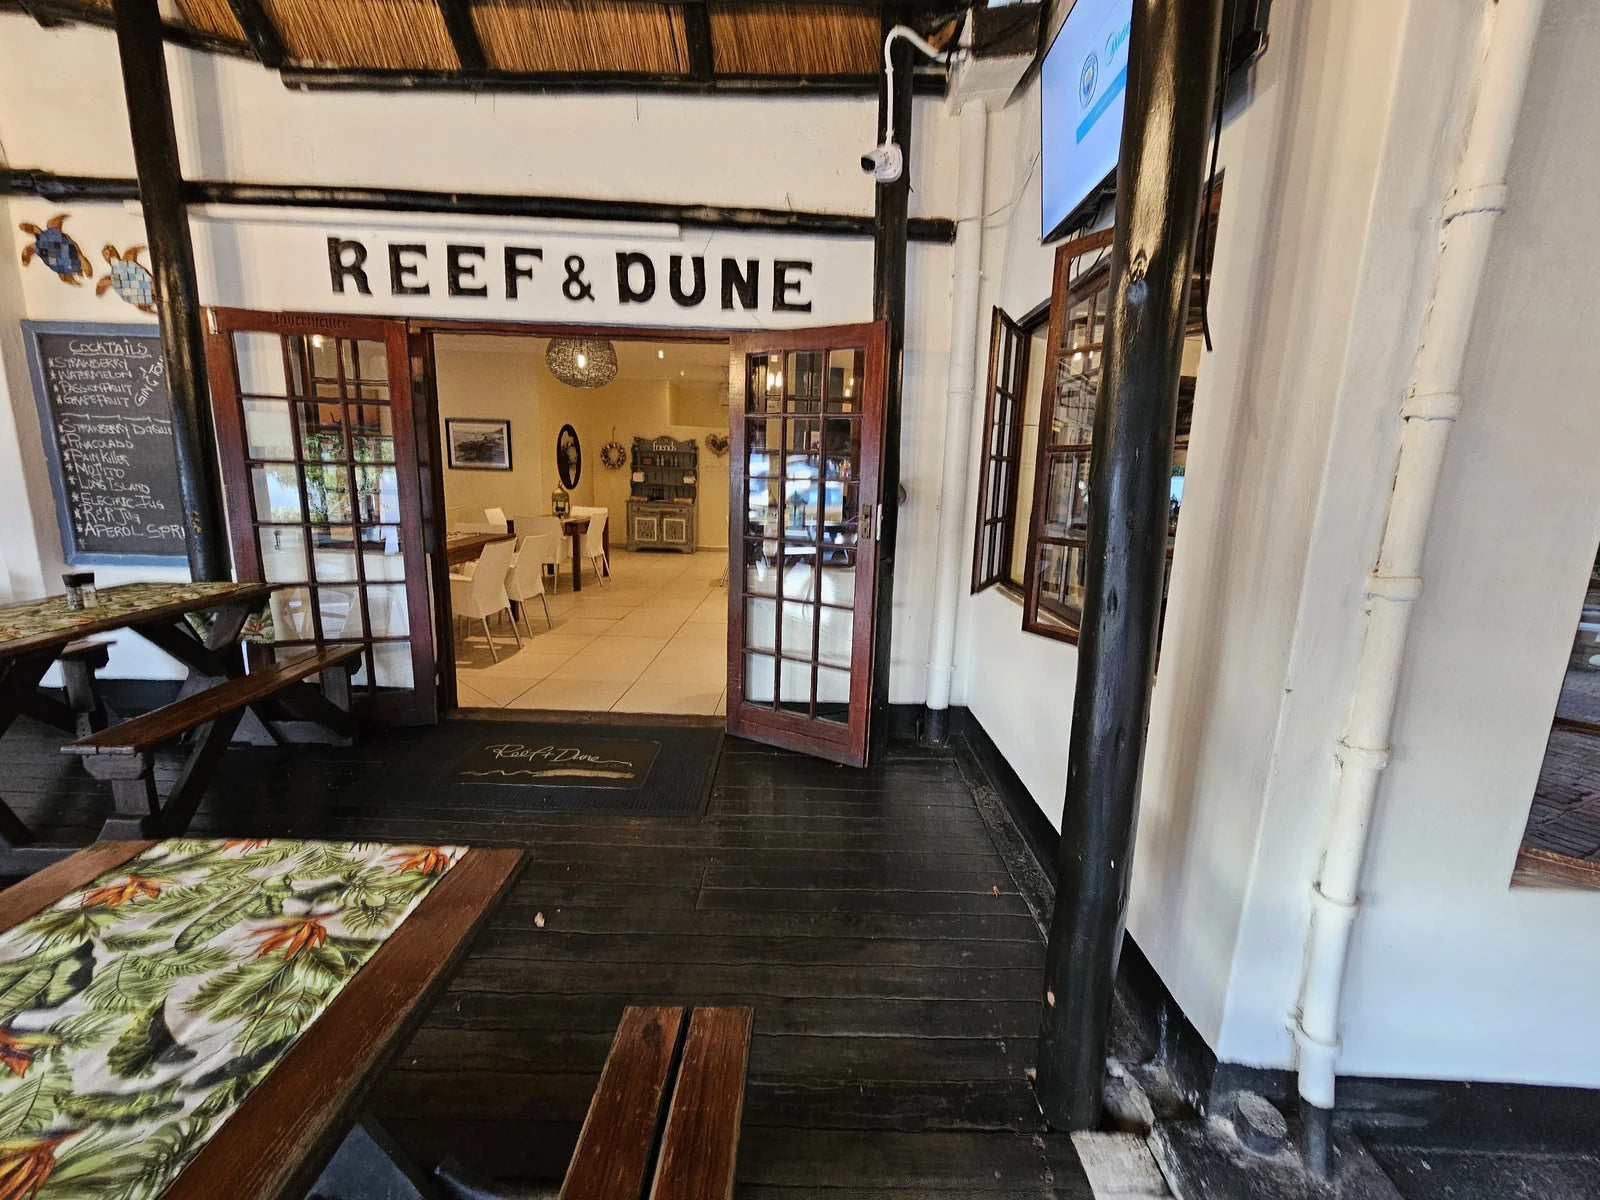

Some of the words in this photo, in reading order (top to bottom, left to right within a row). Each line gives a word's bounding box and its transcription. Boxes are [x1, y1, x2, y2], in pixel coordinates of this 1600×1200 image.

[326, 235, 543, 301] REEF
[562, 254, 595, 304] &
[615, 251, 813, 314] DUNE
[55, 357, 128, 370] STRAWBERRY
[59, 369, 132, 381] WATERMELON
[64, 393, 130, 407] GRAPEFRUIT
[67, 448, 99, 462] PAIN
[80, 493, 135, 508] ELECTRIC
[85, 522, 144, 537] APEROL
